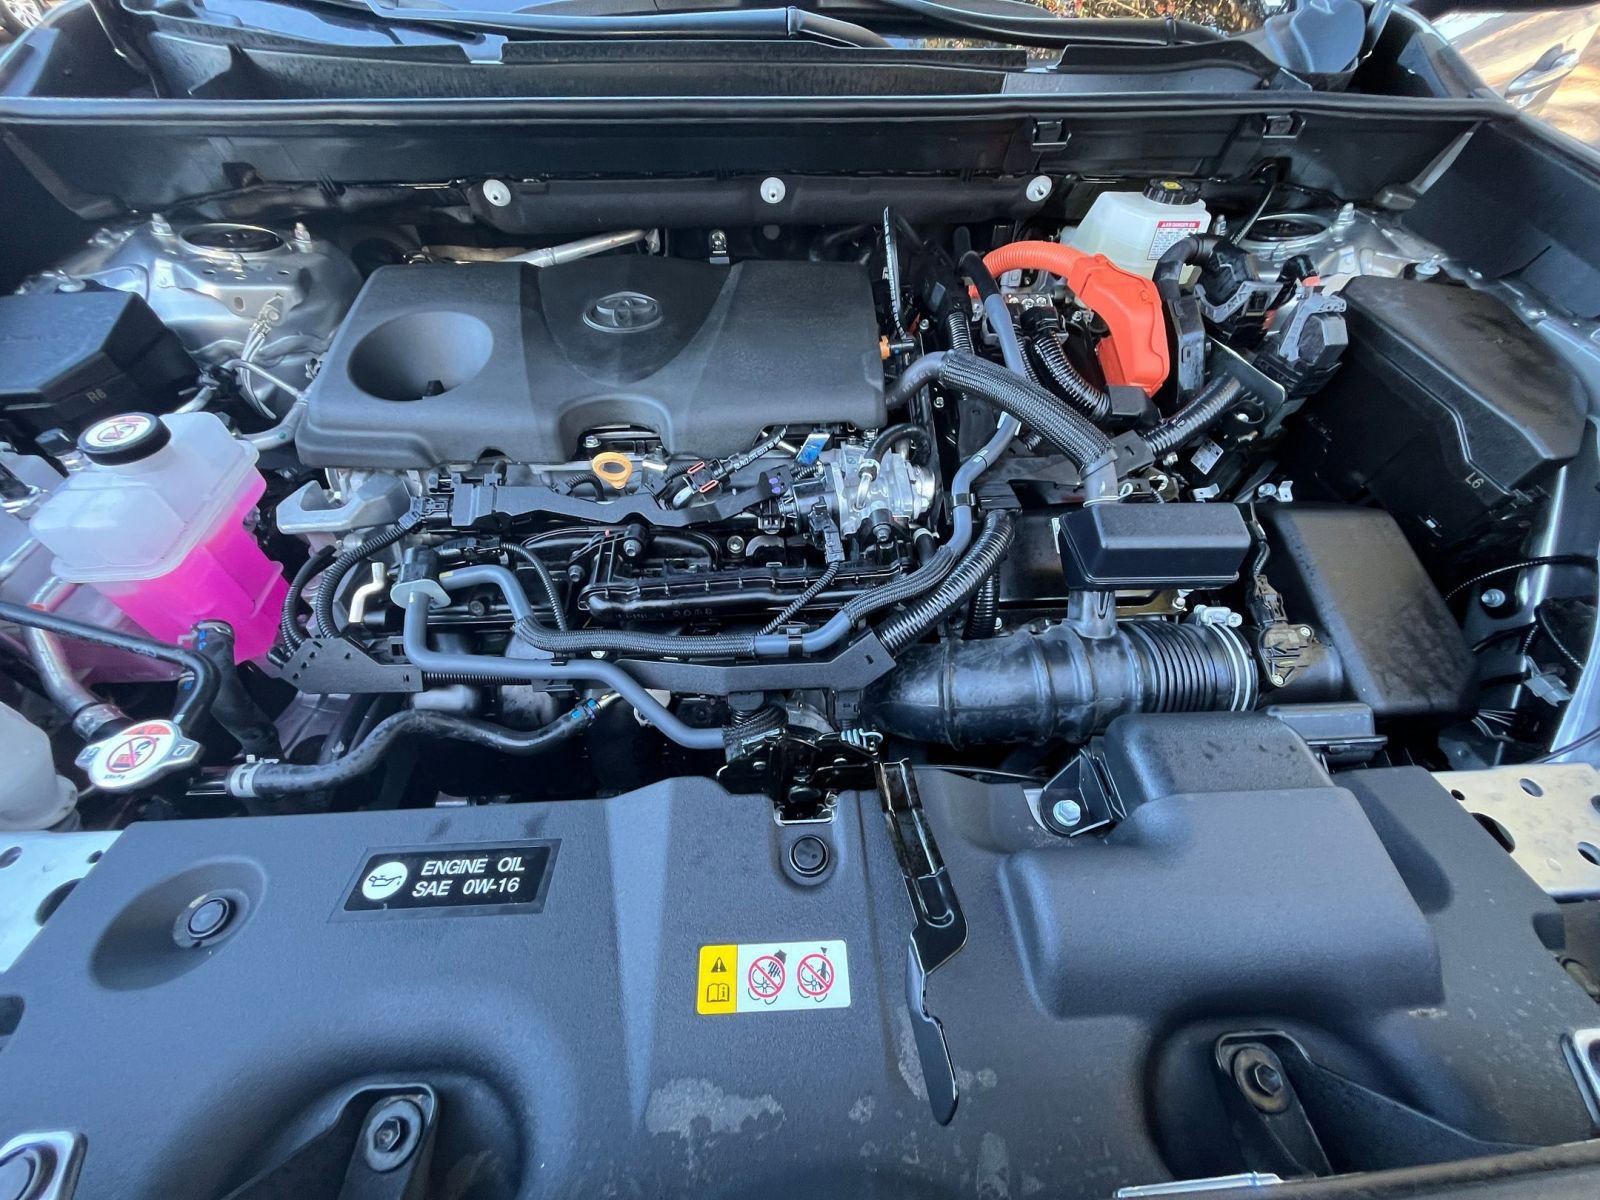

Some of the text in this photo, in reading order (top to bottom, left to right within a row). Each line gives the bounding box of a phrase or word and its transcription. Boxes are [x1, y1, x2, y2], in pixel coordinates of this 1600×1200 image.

[1465, 472, 1484, 488] L6
[421, 856, 525, 876] ENGINE OIL
[412, 877, 521, 898] SAE 0W-16
